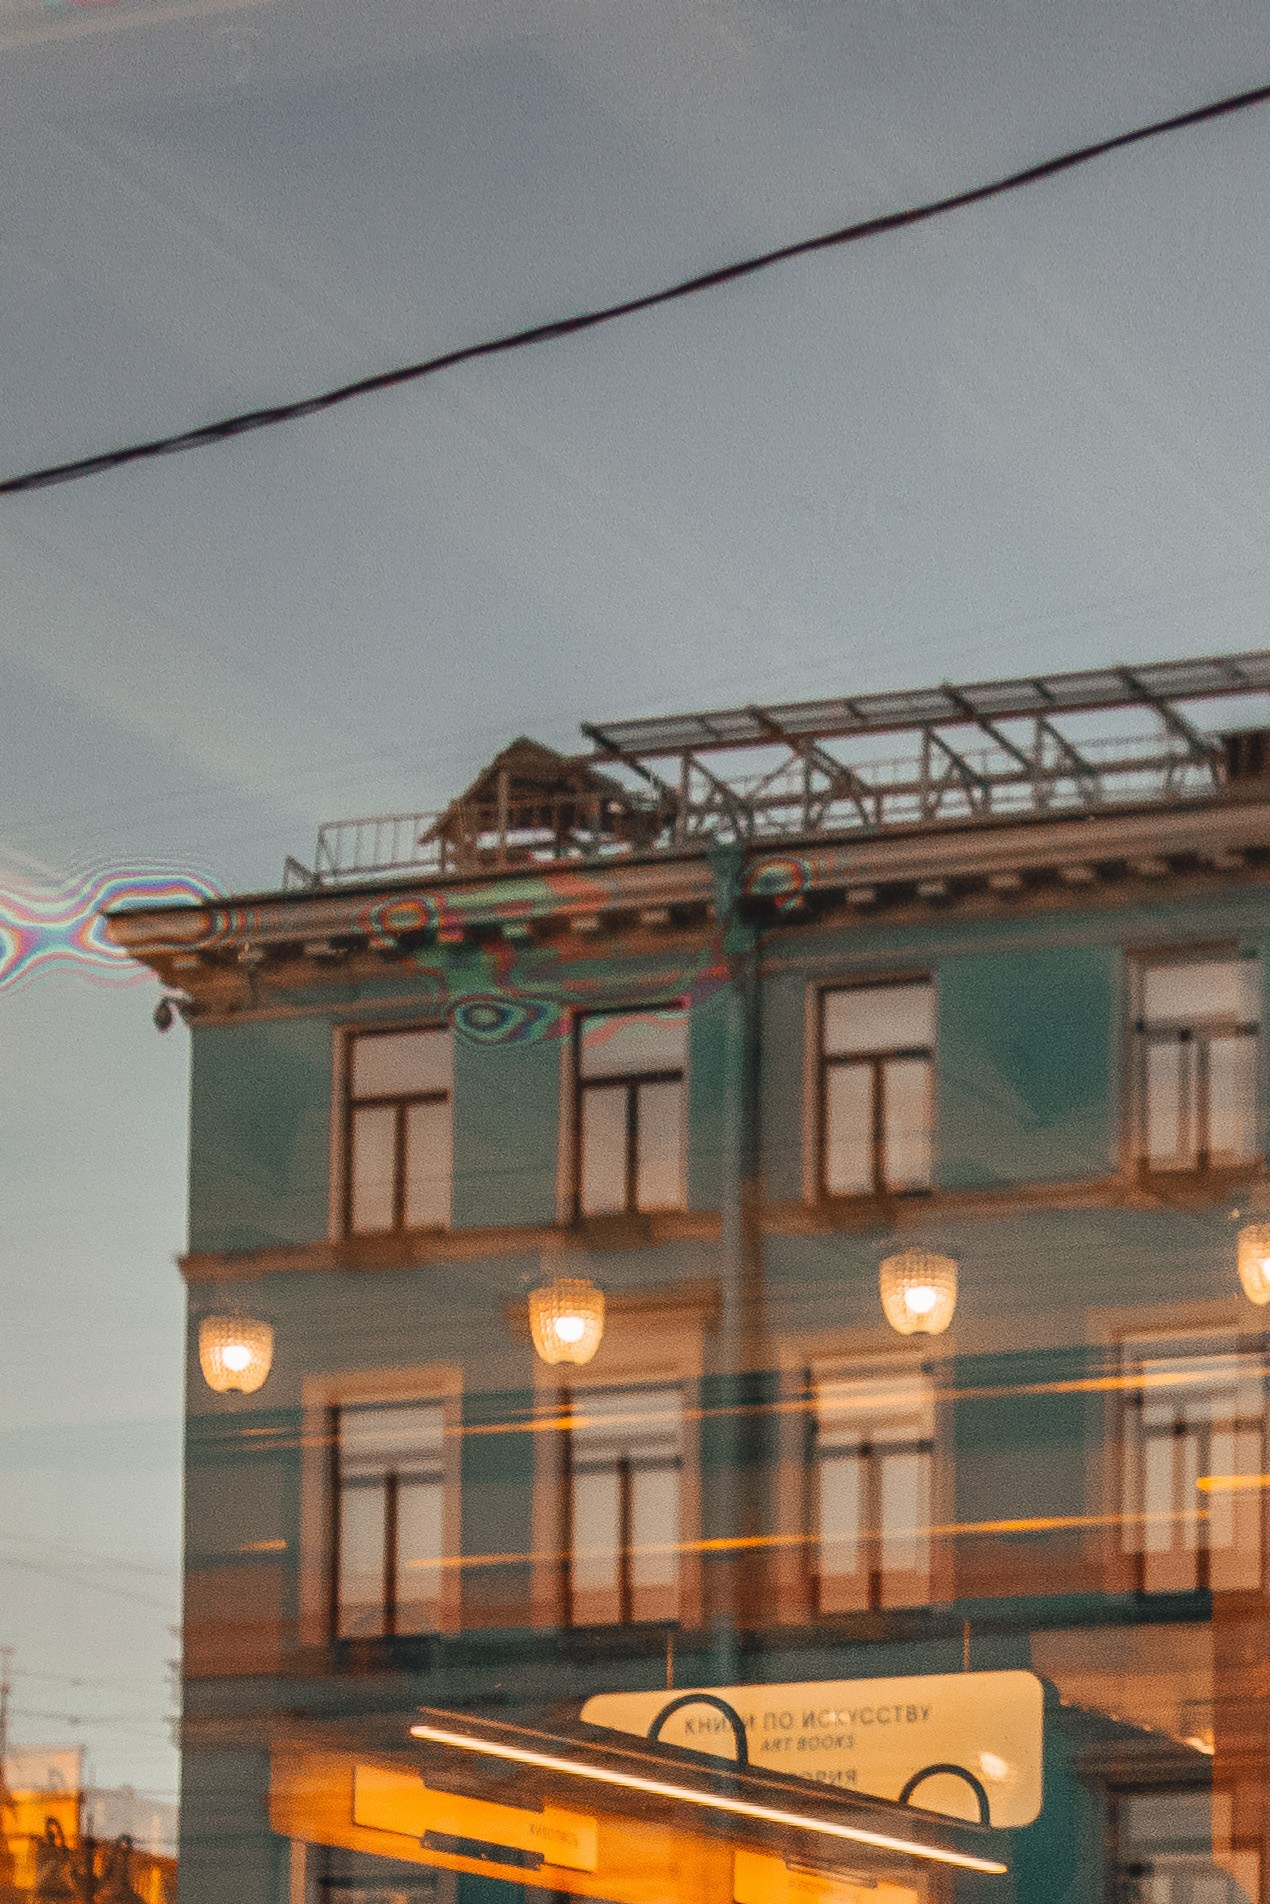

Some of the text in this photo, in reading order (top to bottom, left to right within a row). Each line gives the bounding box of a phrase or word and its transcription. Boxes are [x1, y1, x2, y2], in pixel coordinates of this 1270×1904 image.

[685, 1713, 756, 1735] КНИИ
[762, 1710, 795, 1730] ПО
[761, 1733, 856, 1752] ART BOOKS
